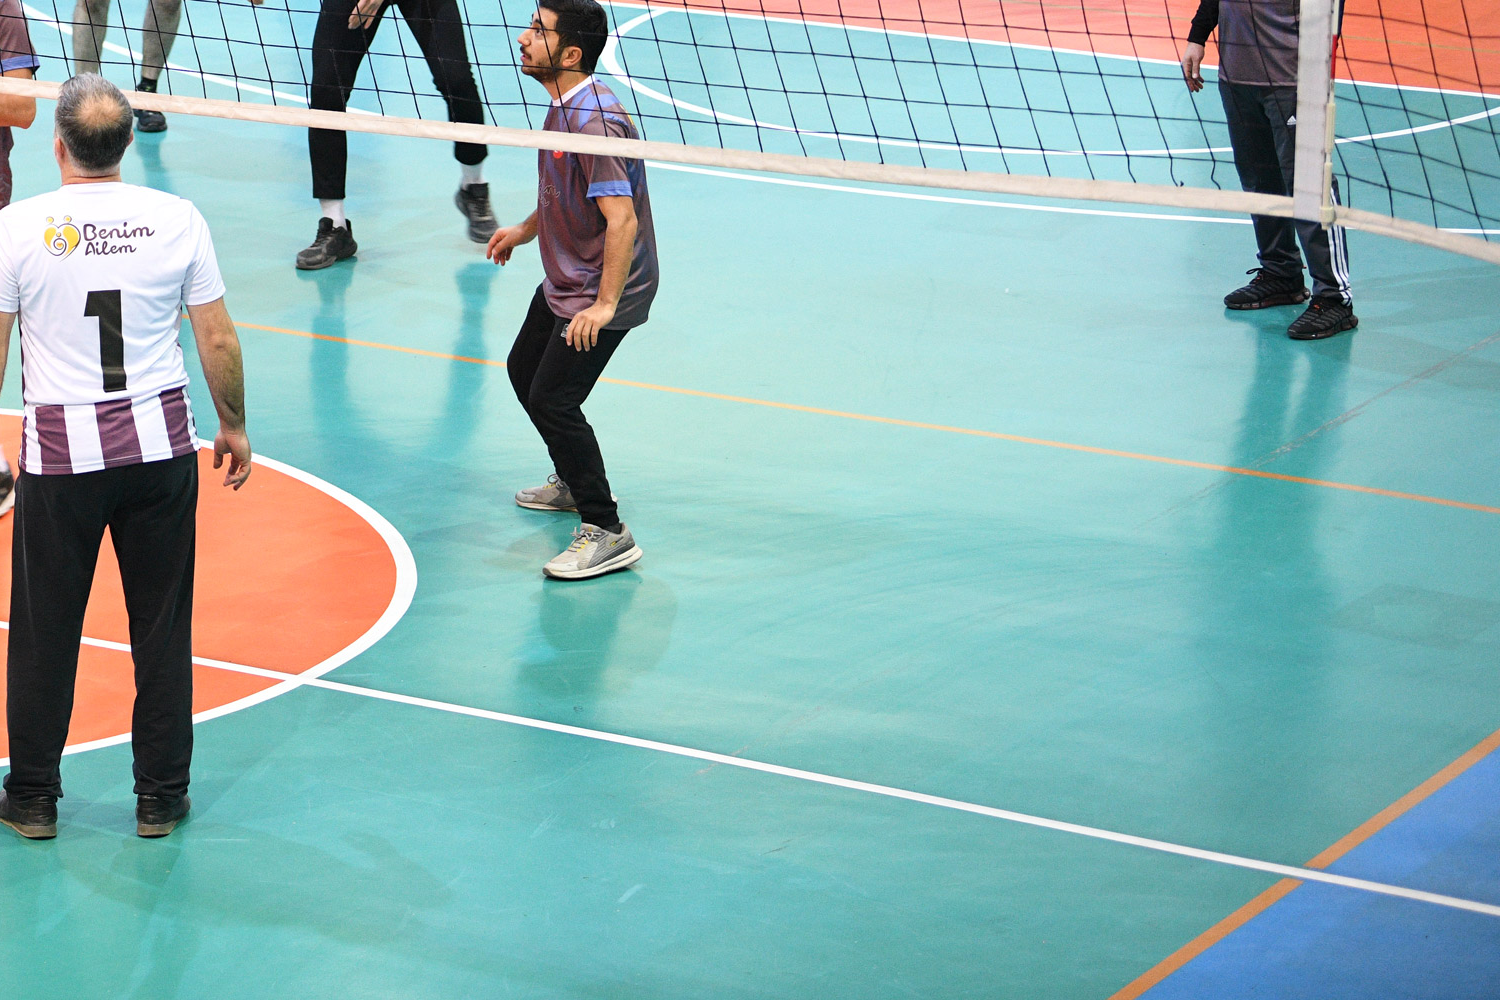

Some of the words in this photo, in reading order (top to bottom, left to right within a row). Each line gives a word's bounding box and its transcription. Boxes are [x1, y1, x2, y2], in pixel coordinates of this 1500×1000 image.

[82, 221, 155, 241] Benim
[84, 241, 137, 256] Ailem
[83, 289, 127, 393] 1
